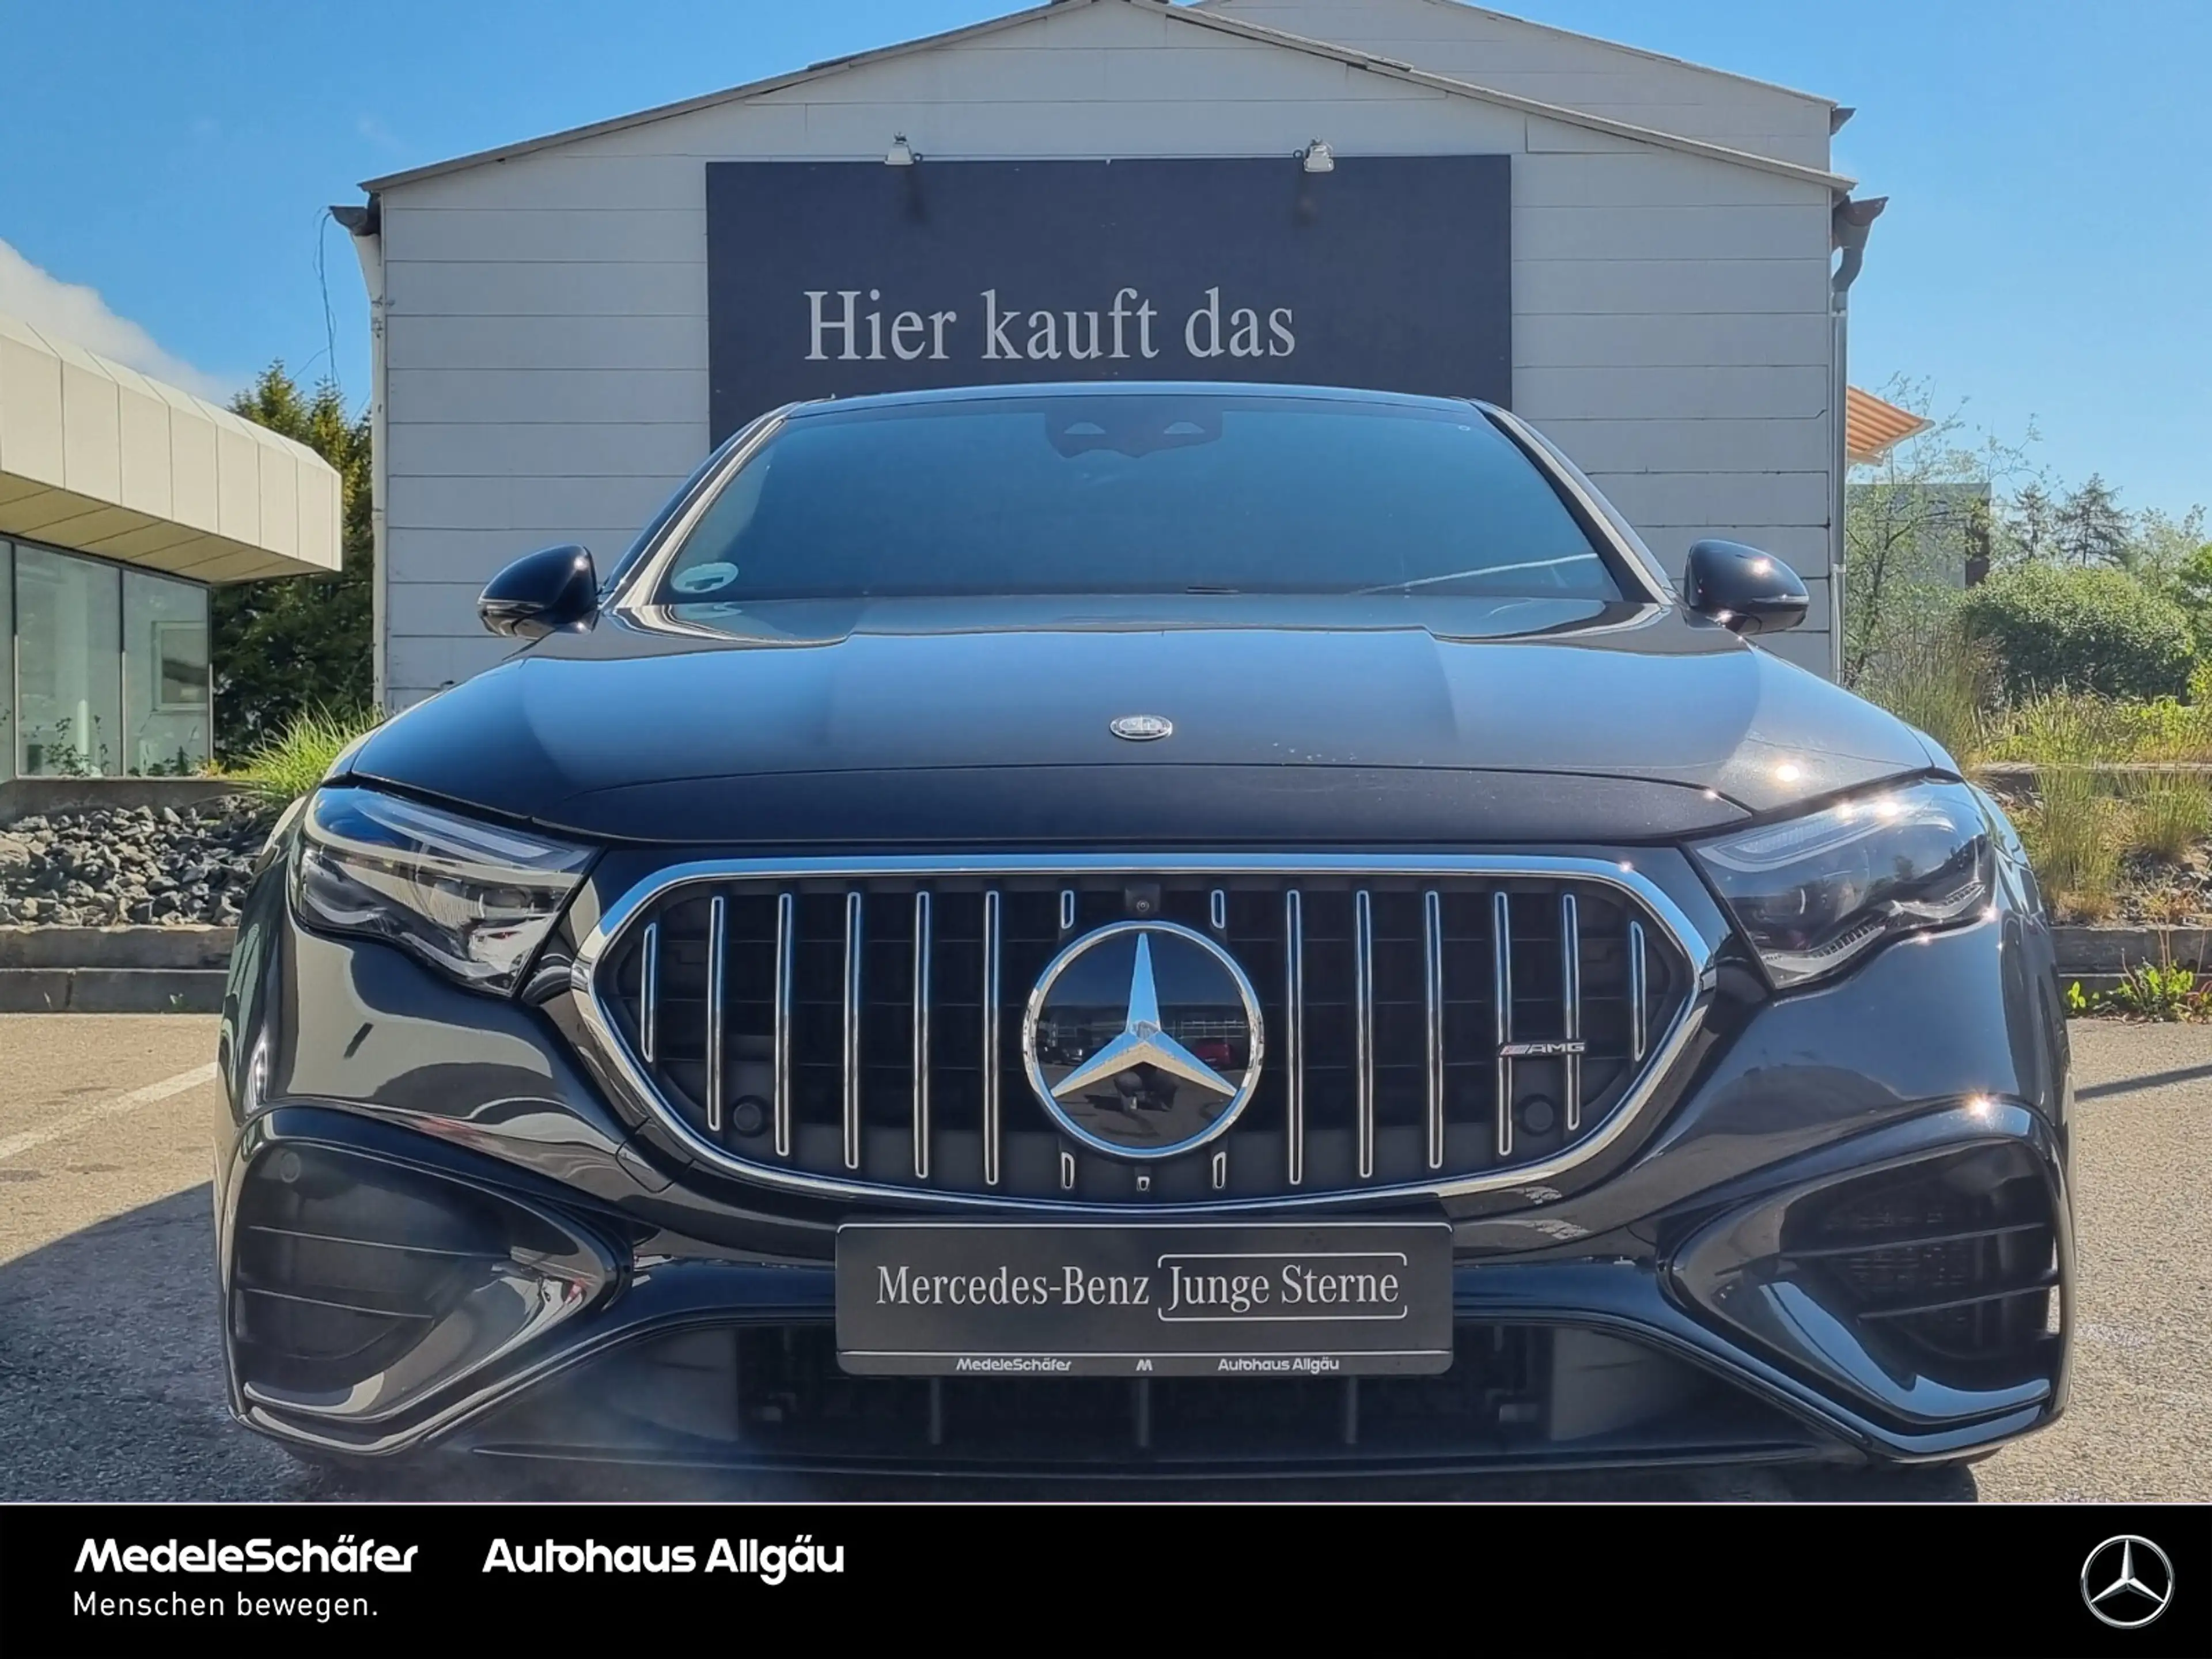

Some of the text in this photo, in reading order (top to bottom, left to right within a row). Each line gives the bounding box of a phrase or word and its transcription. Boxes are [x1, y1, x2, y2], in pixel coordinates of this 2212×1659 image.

[804, 286, 1295, 360] Hier kauft das
[1527, 1041, 1585, 1054] AMG
[876, 1264, 1399, 1312] Mercedes-Benz Junge Sterne
[956, 1357, 1072, 1372] MedeleSchäfer
[1217, 1356, 1340, 1374] Autohaus Allgäu
